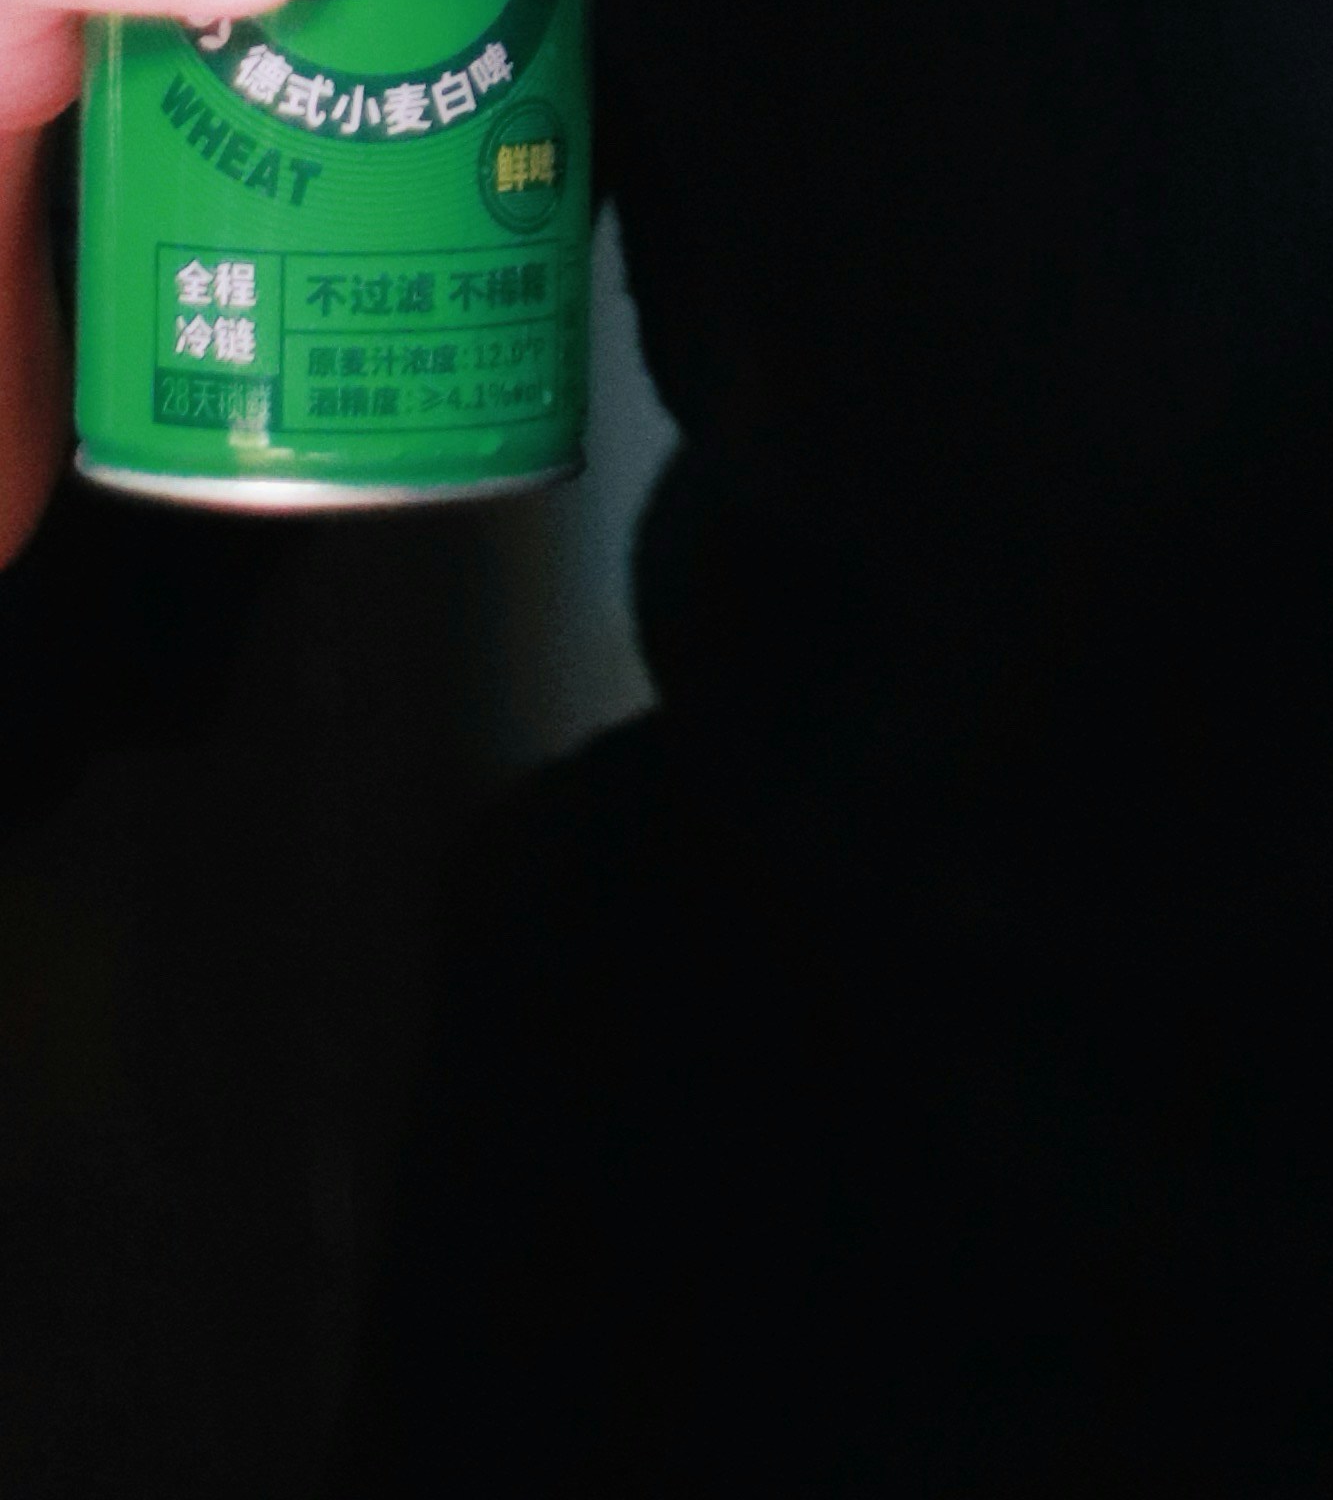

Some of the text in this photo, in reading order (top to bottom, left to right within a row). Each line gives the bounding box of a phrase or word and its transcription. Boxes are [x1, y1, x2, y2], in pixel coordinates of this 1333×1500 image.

[234, 42, 514, 136] 德式小麦白啤
[160, 71, 323, 207] WHEAT
[175, 258, 257, 307] 全程
[306, 270, 437, 317] 不过滤
[174, 313, 257, 365] 冷链
